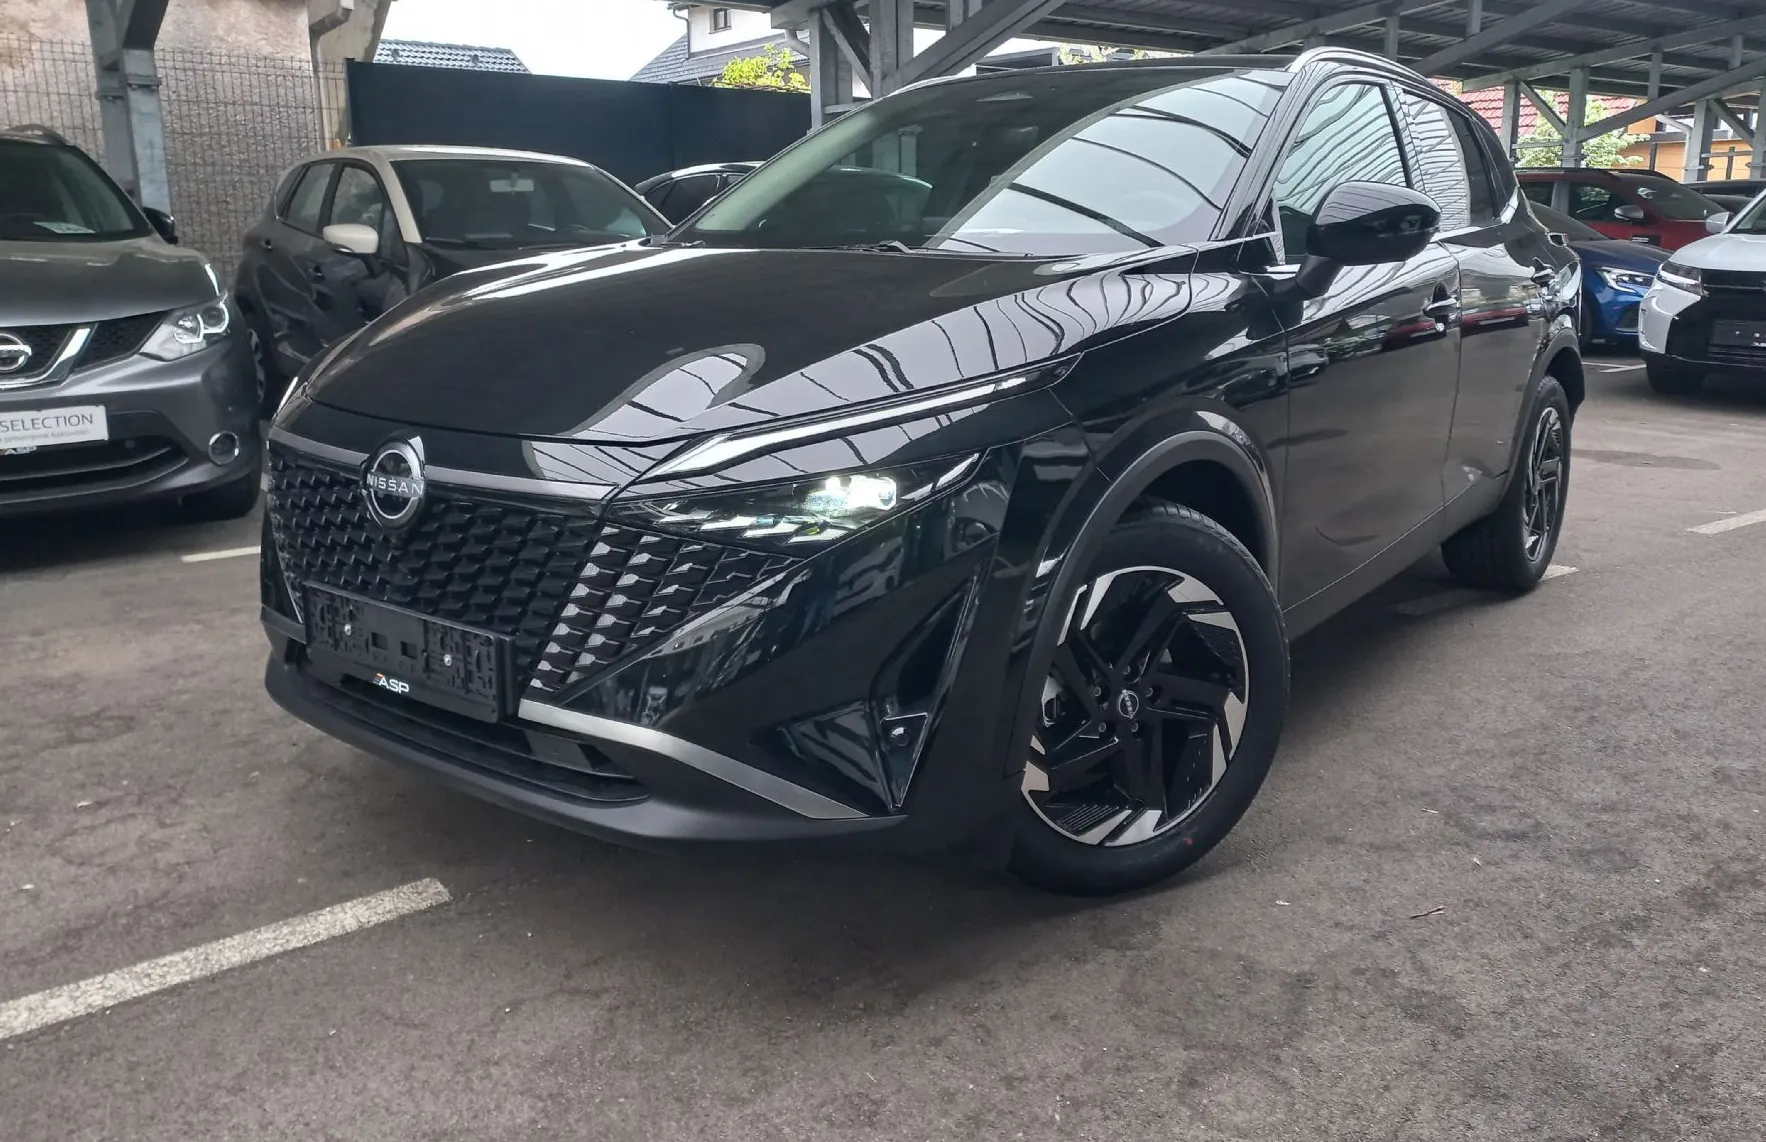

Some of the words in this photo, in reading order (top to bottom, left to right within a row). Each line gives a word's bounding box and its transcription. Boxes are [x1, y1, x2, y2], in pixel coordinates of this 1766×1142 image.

[0, 413, 93, 434] SELECTION
[366, 473, 424, 495] NISSAN
[378, 676, 410, 694] ASP
